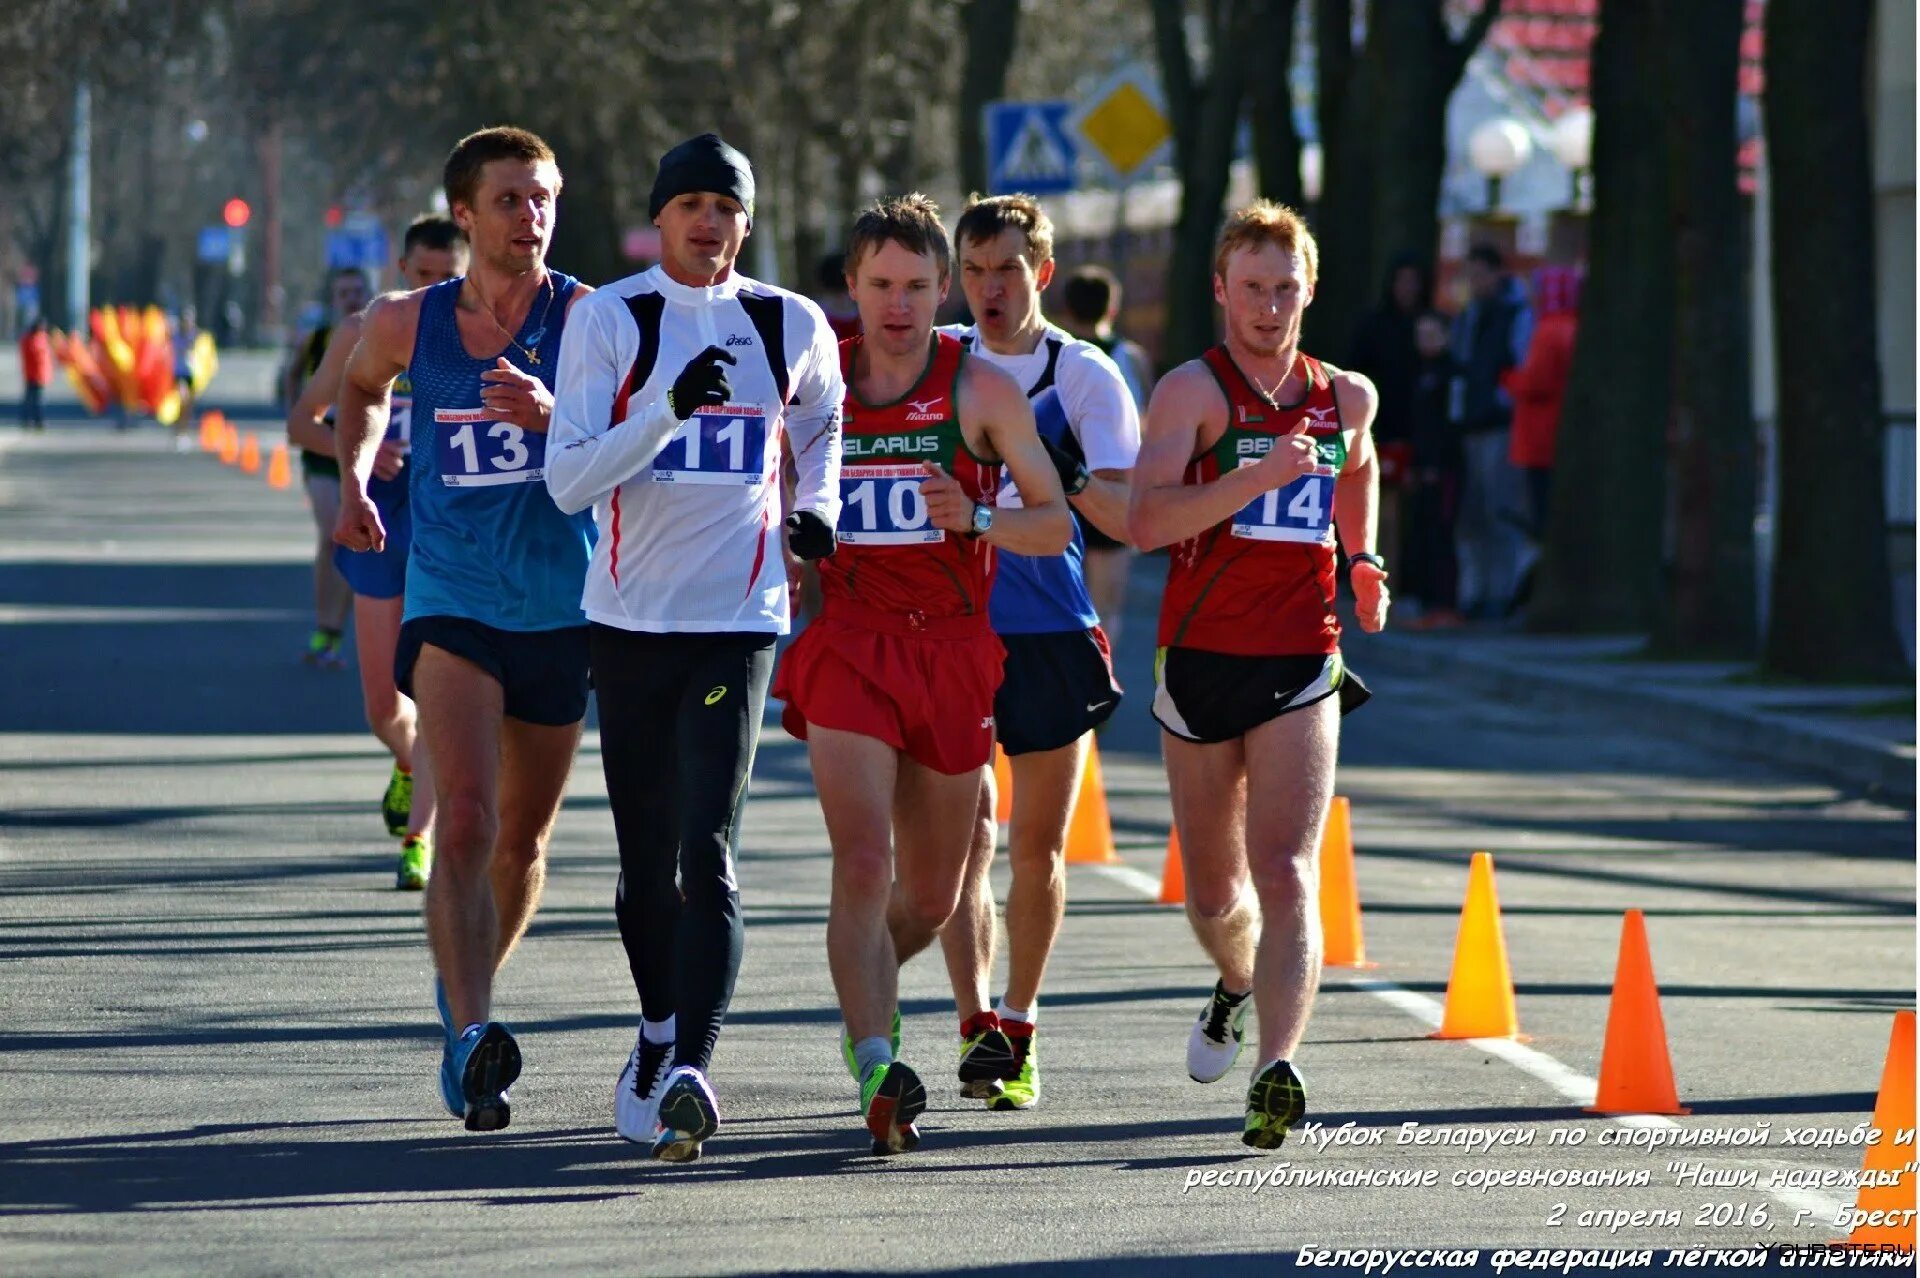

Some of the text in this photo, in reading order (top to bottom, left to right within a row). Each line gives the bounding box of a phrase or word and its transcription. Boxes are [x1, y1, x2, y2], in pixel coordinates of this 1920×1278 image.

[450, 421, 529, 473] 13
[672, 417, 745, 471] 11
[842, 435, 939, 456] ELARUS
[847, 480, 929, 531] 10
[1262, 477, 1323, 528] 14
